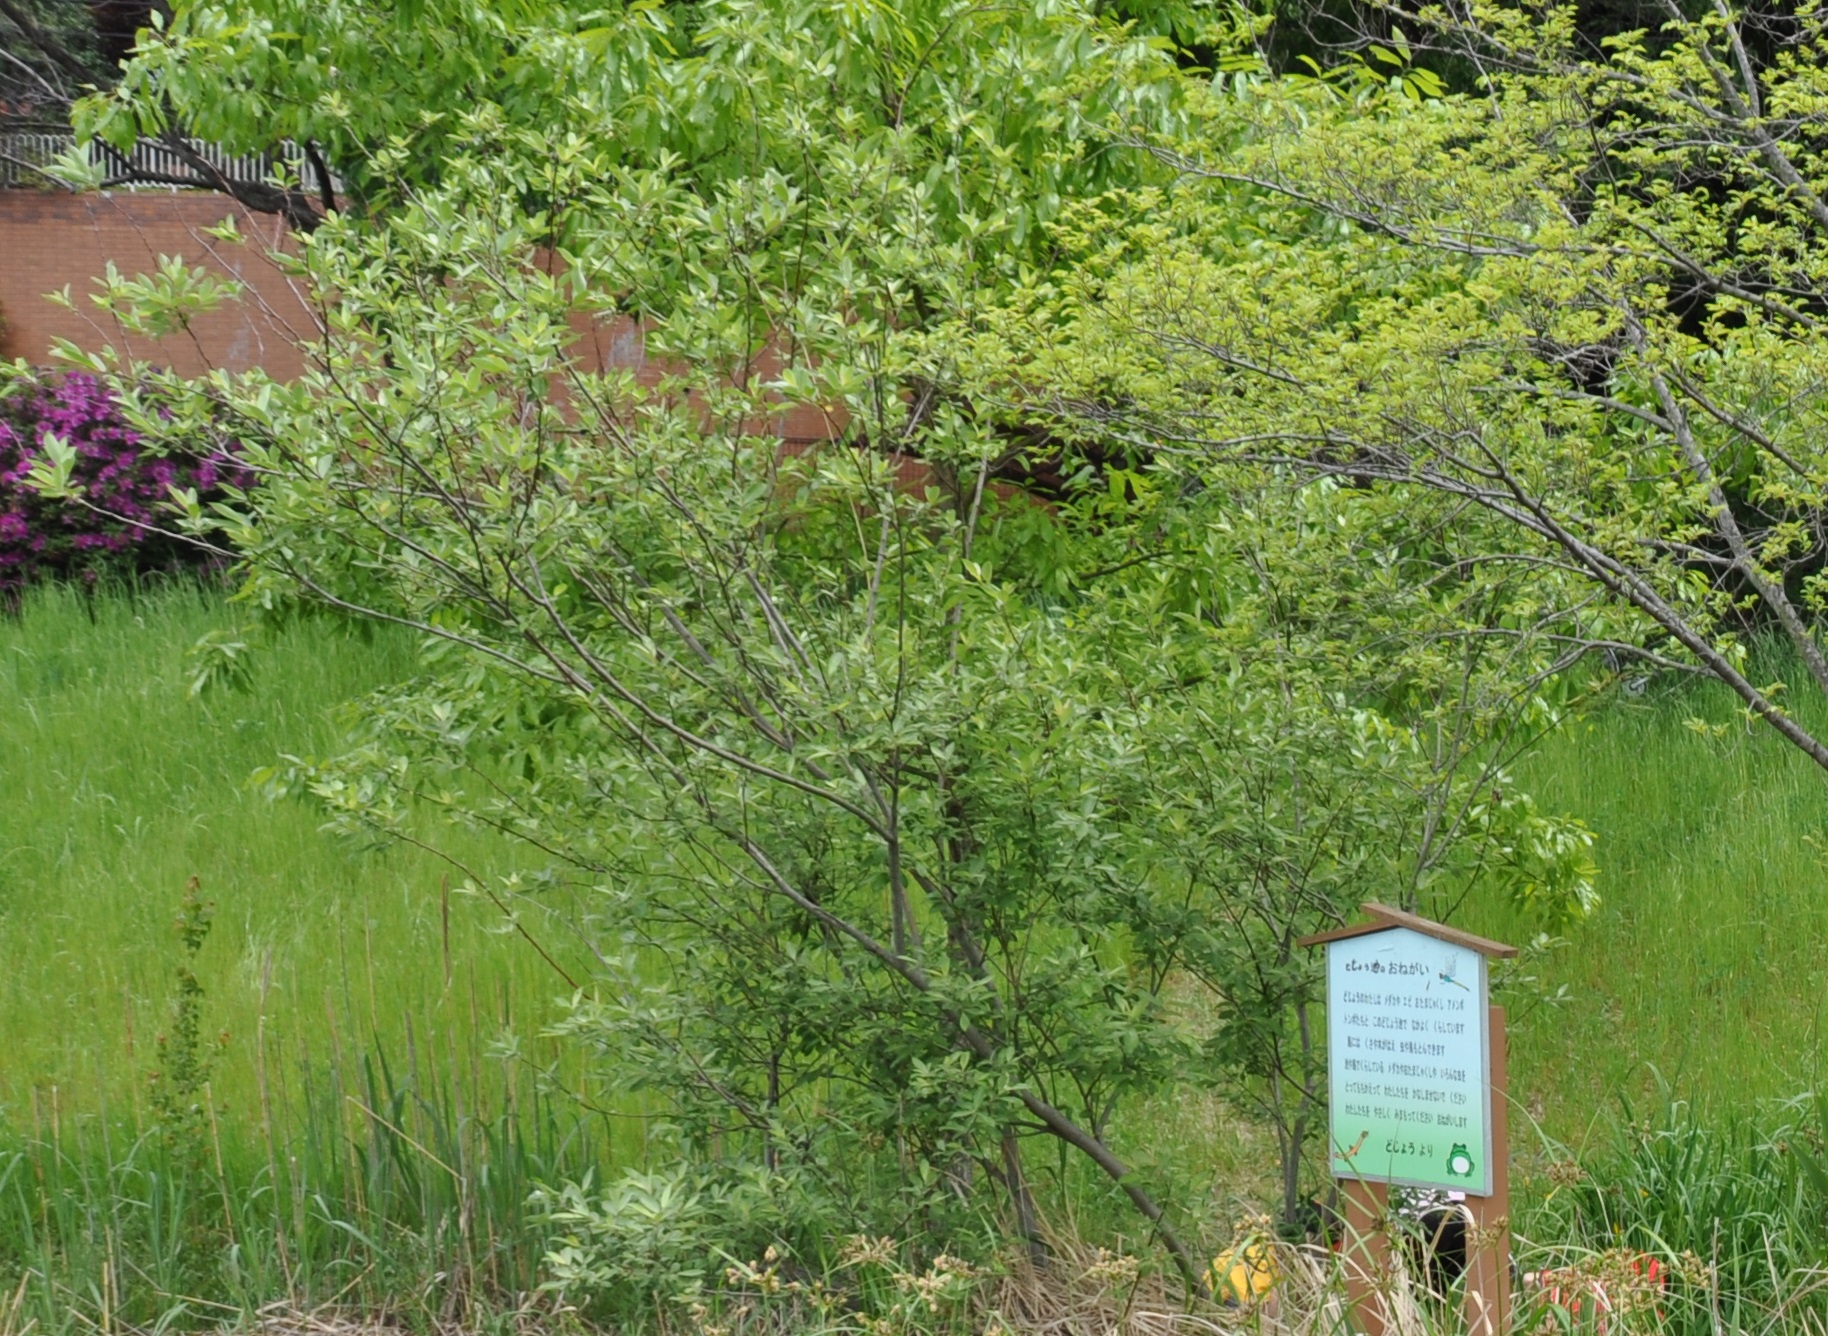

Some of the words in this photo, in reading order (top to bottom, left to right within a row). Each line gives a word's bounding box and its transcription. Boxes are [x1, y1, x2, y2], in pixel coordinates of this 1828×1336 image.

[1385, 1139, 1415, 1156] どじょう
[1419, 1144, 1433, 1158] より
